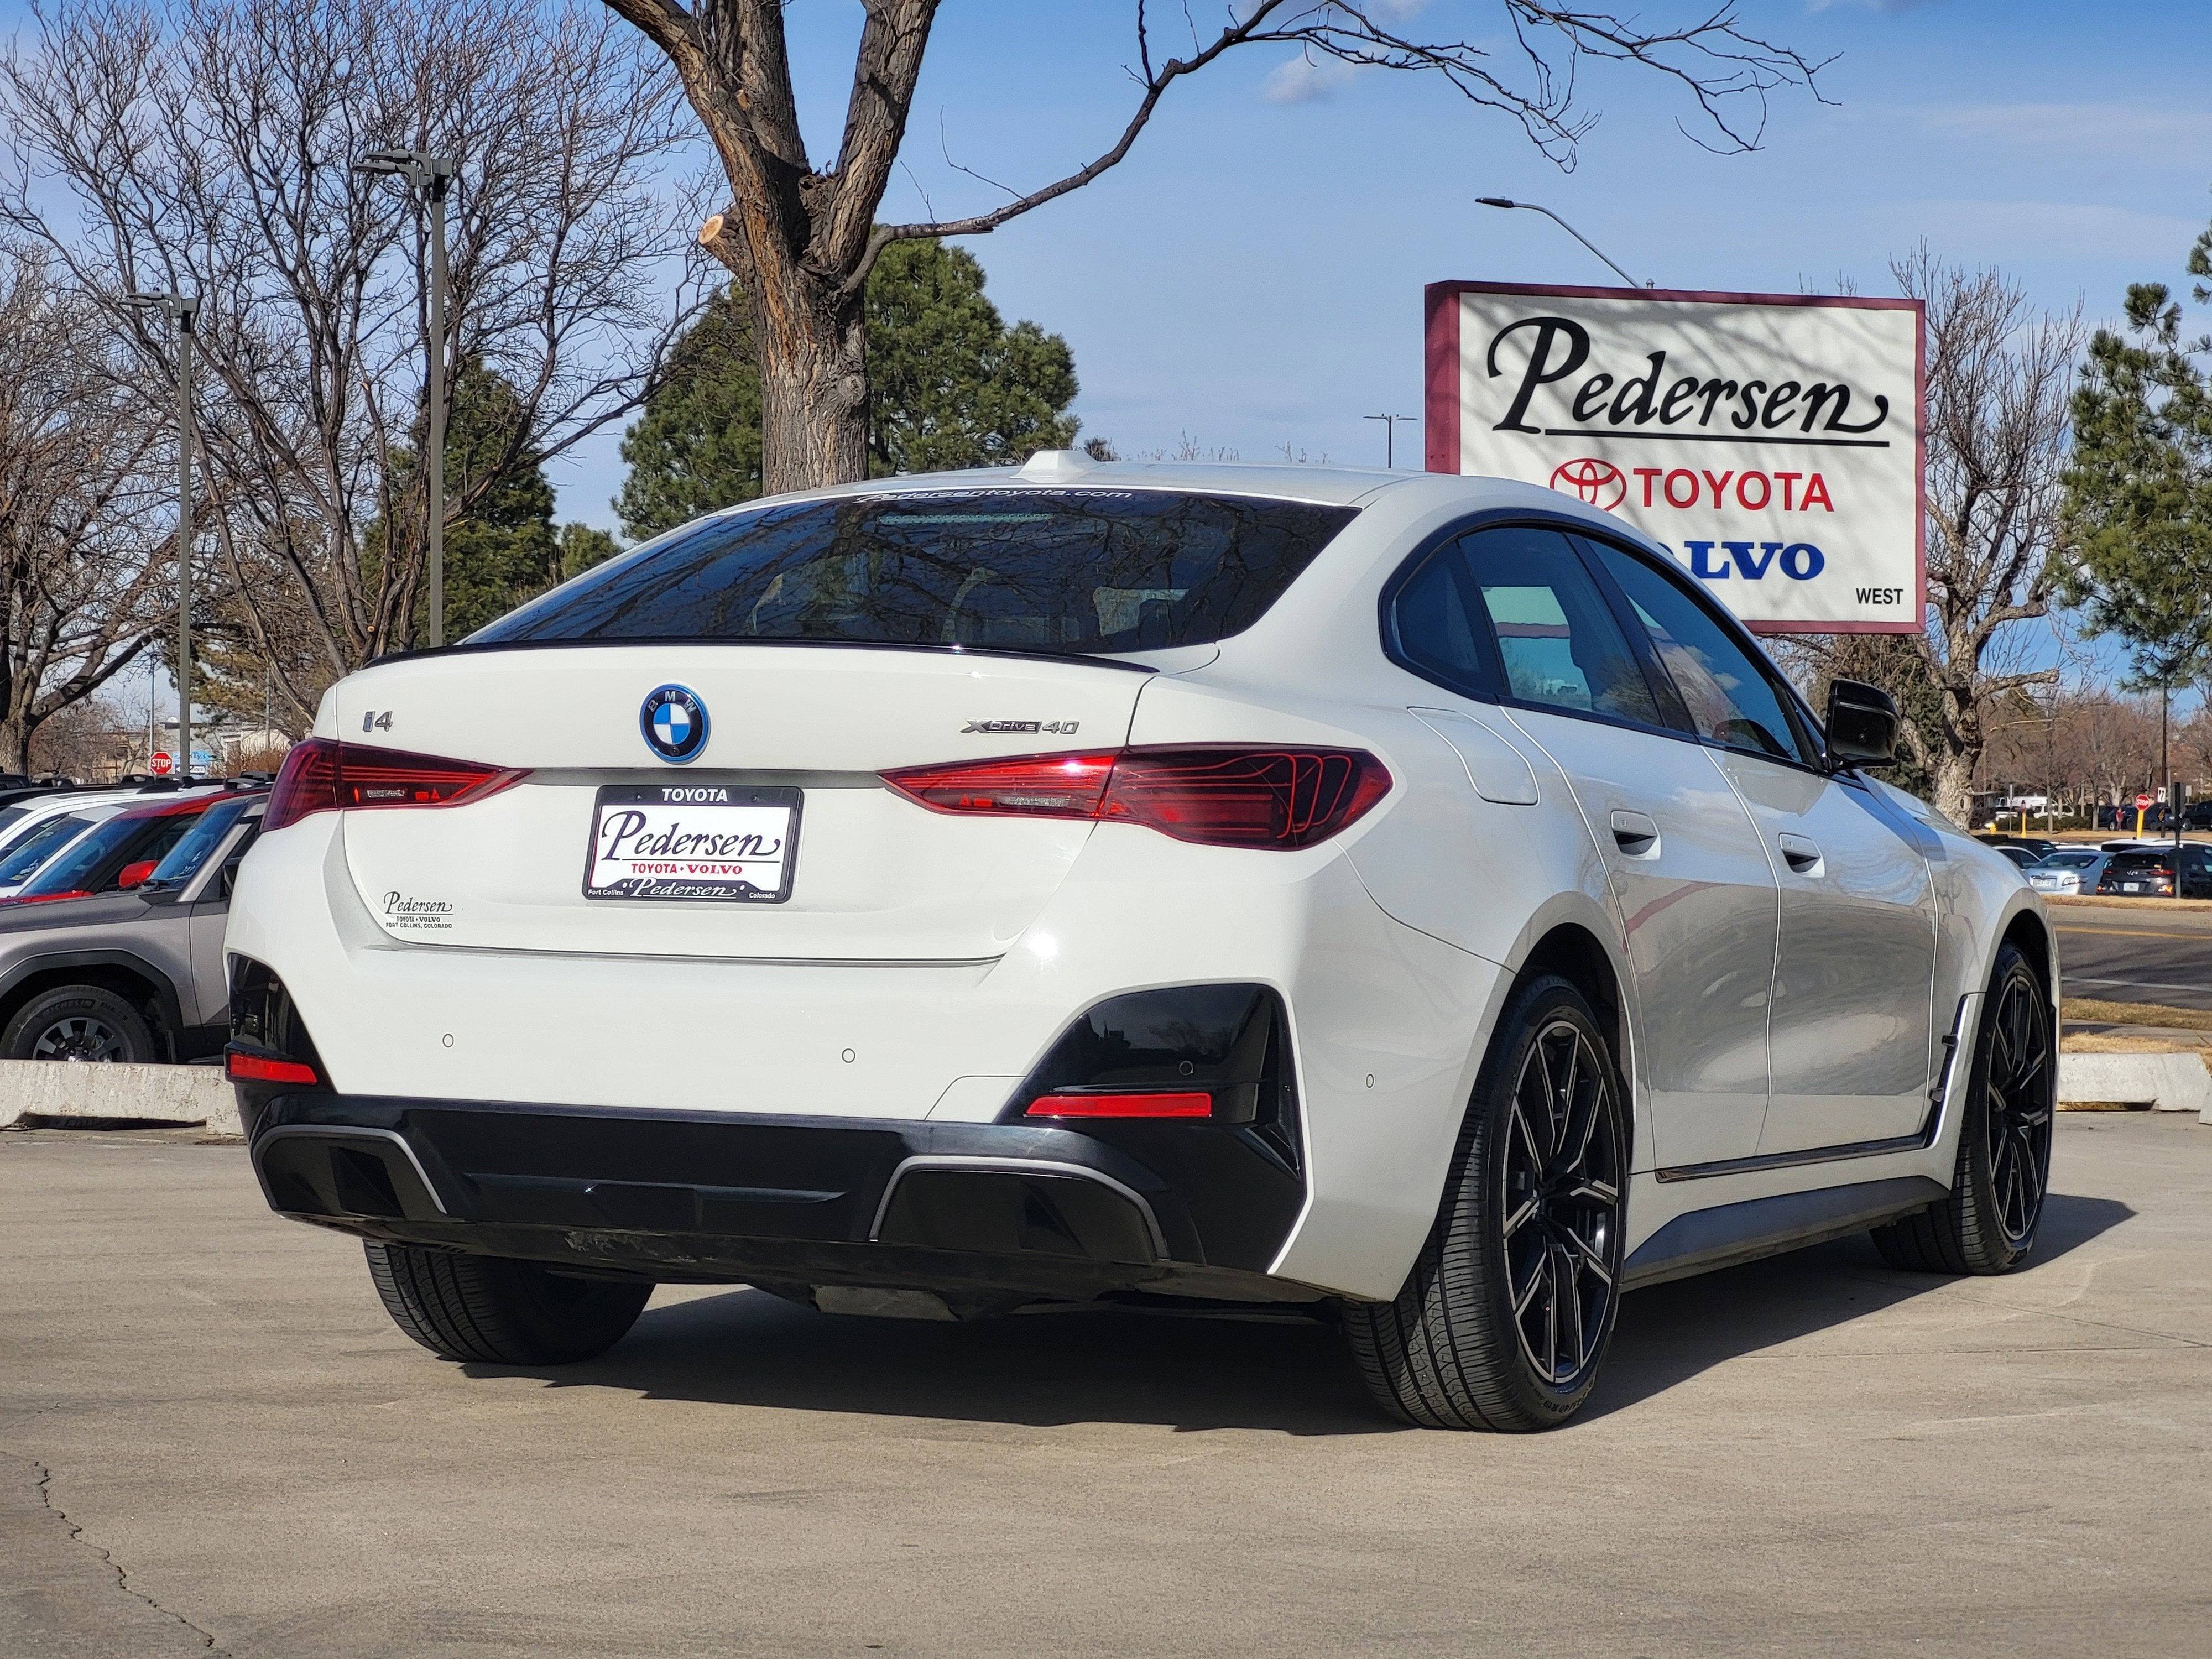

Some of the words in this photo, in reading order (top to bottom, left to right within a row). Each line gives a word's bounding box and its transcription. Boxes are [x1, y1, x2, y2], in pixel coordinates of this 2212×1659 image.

[1486, 316, 1889, 434] Pedersen
[1633, 468, 1834, 512] TOYOTA
[1658, 540, 1825, 581] LVO
[1856, 587, 1904, 605] WEST
[648, 691, 697, 713] BMW
[151, 758, 171, 769] STOP
[662, 788, 728, 802] TOYOTA
[601, 810, 780, 861] Pedersen
[631, 863, 677, 874] TOYOTA
[686, 864, 743, 874] VOLVO
[629, 877, 737, 898] Pedersen
[383, 891, 453, 914] Pedersen
